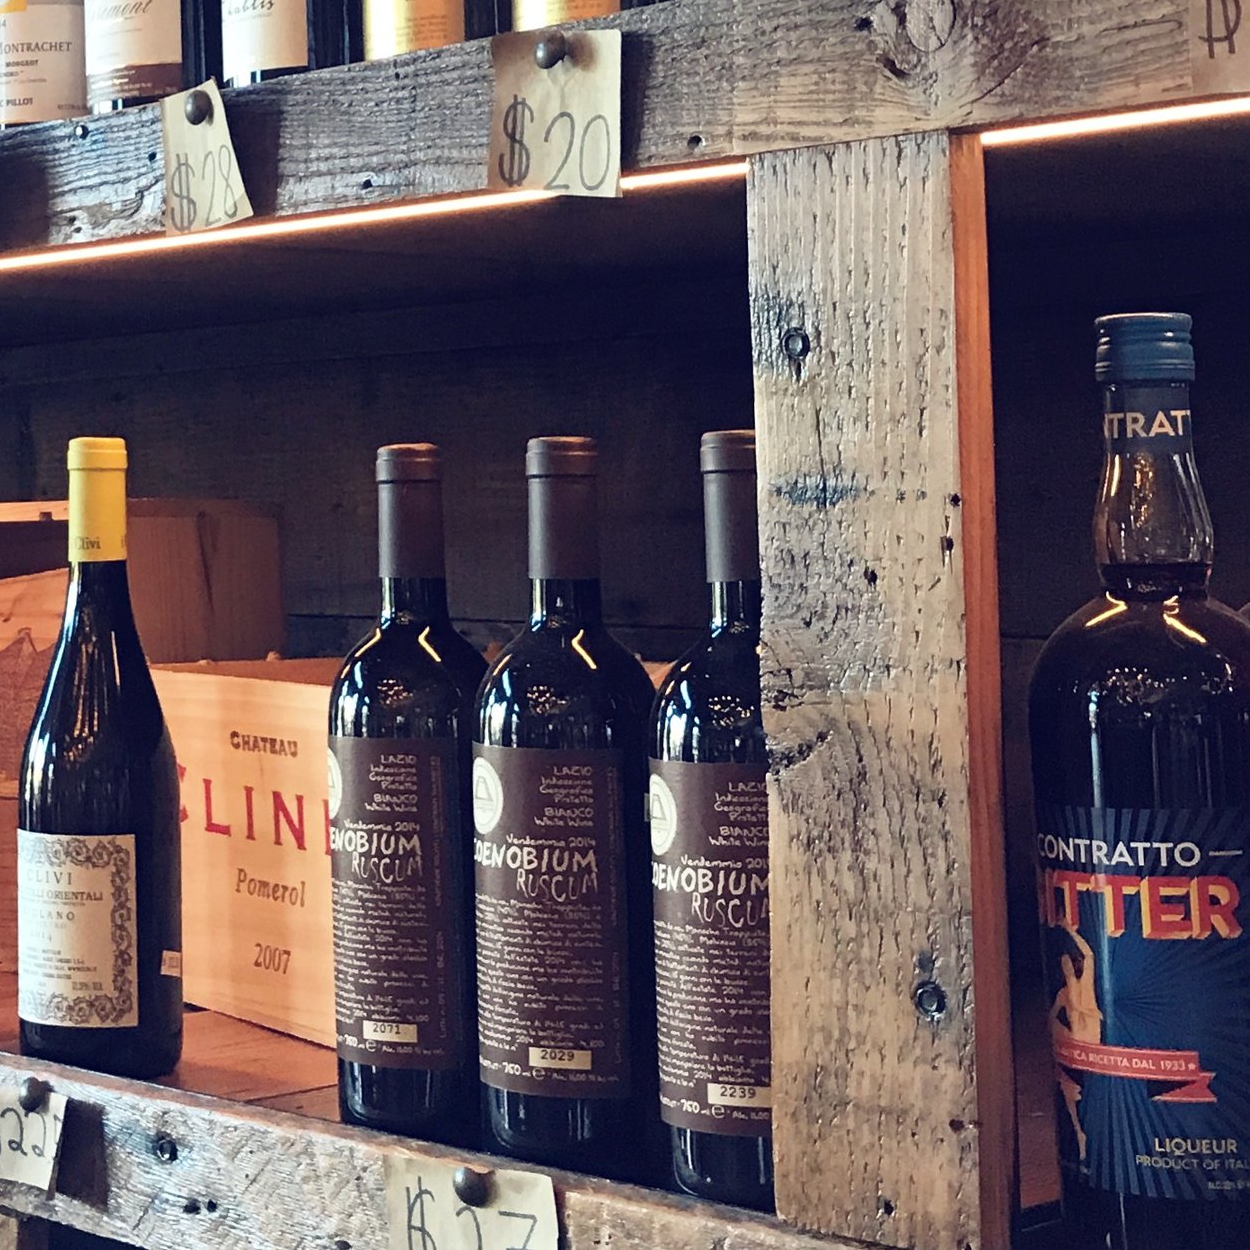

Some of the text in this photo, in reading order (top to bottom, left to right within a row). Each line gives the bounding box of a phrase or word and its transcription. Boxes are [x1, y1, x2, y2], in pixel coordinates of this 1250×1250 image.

[498, 93, 612, 192] $20
[170, 144, 238, 233] $28
[229, 730, 299, 758] CHATEAU
[544, 806, 595, 818] BIANCO
[1036, 832, 1202, 868] CONTRATTO
[46, 890, 104, 901] ORIENTALI
[234, 867, 307, 908] Pomerol
[515, 867, 599, 903] RUSCUM
[253, 942, 292, 975] 2007
[540, 1050, 576, 1062] 2029
[1088, 1054, 1130, 1067] RICETTA
[1132, 1058, 1156, 1070] DAL
[1159, 1059, 1186, 1072] 1933
[719, 1085, 756, 1099] 2239
[1153, 1137, 1238, 1156] LIQUEUR
[1135, 1154, 1200, 1171] PRODUCT
[1202, 1158, 1222, 1170] OF
